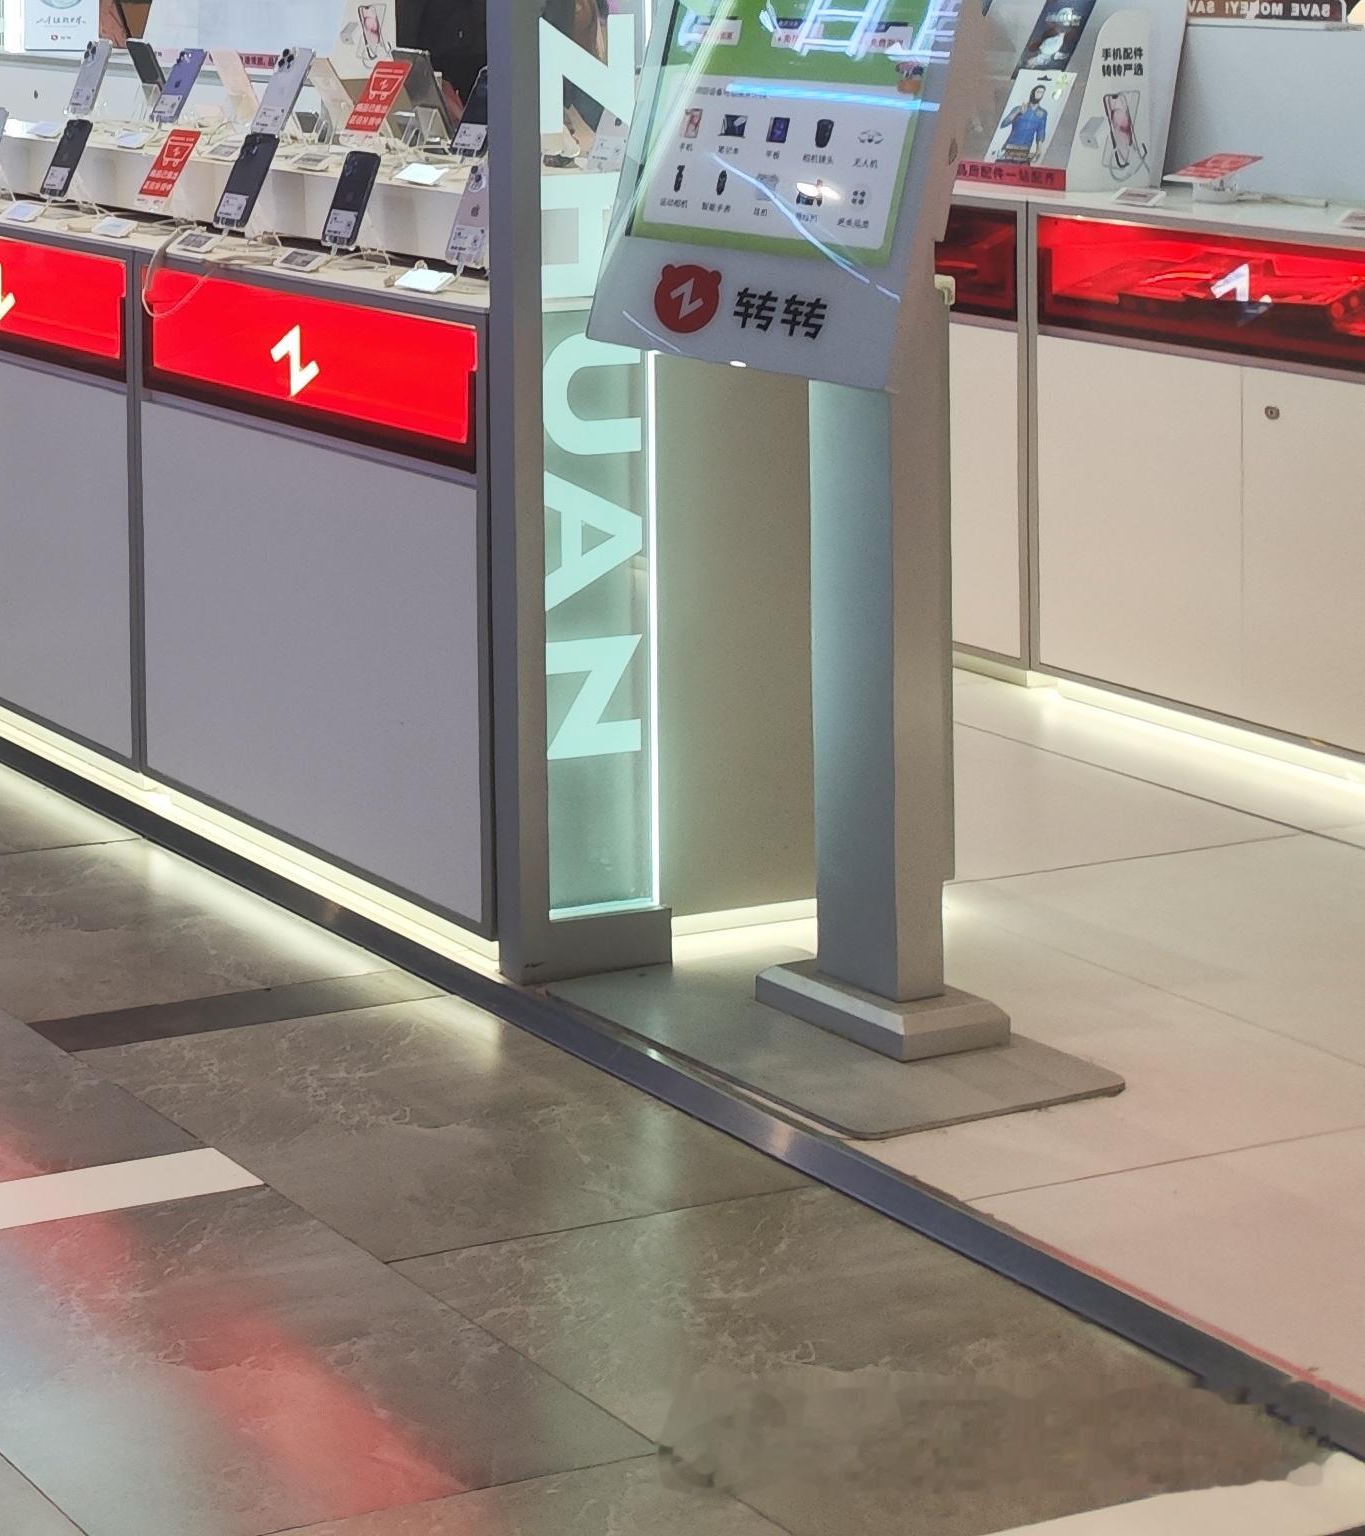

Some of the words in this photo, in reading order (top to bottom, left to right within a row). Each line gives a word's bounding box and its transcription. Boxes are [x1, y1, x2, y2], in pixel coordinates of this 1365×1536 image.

[1101, 46, 1144, 61] 手机配件
[1101, 63, 1144, 77] 转转严选
[733, 287, 828, 339] 转转
